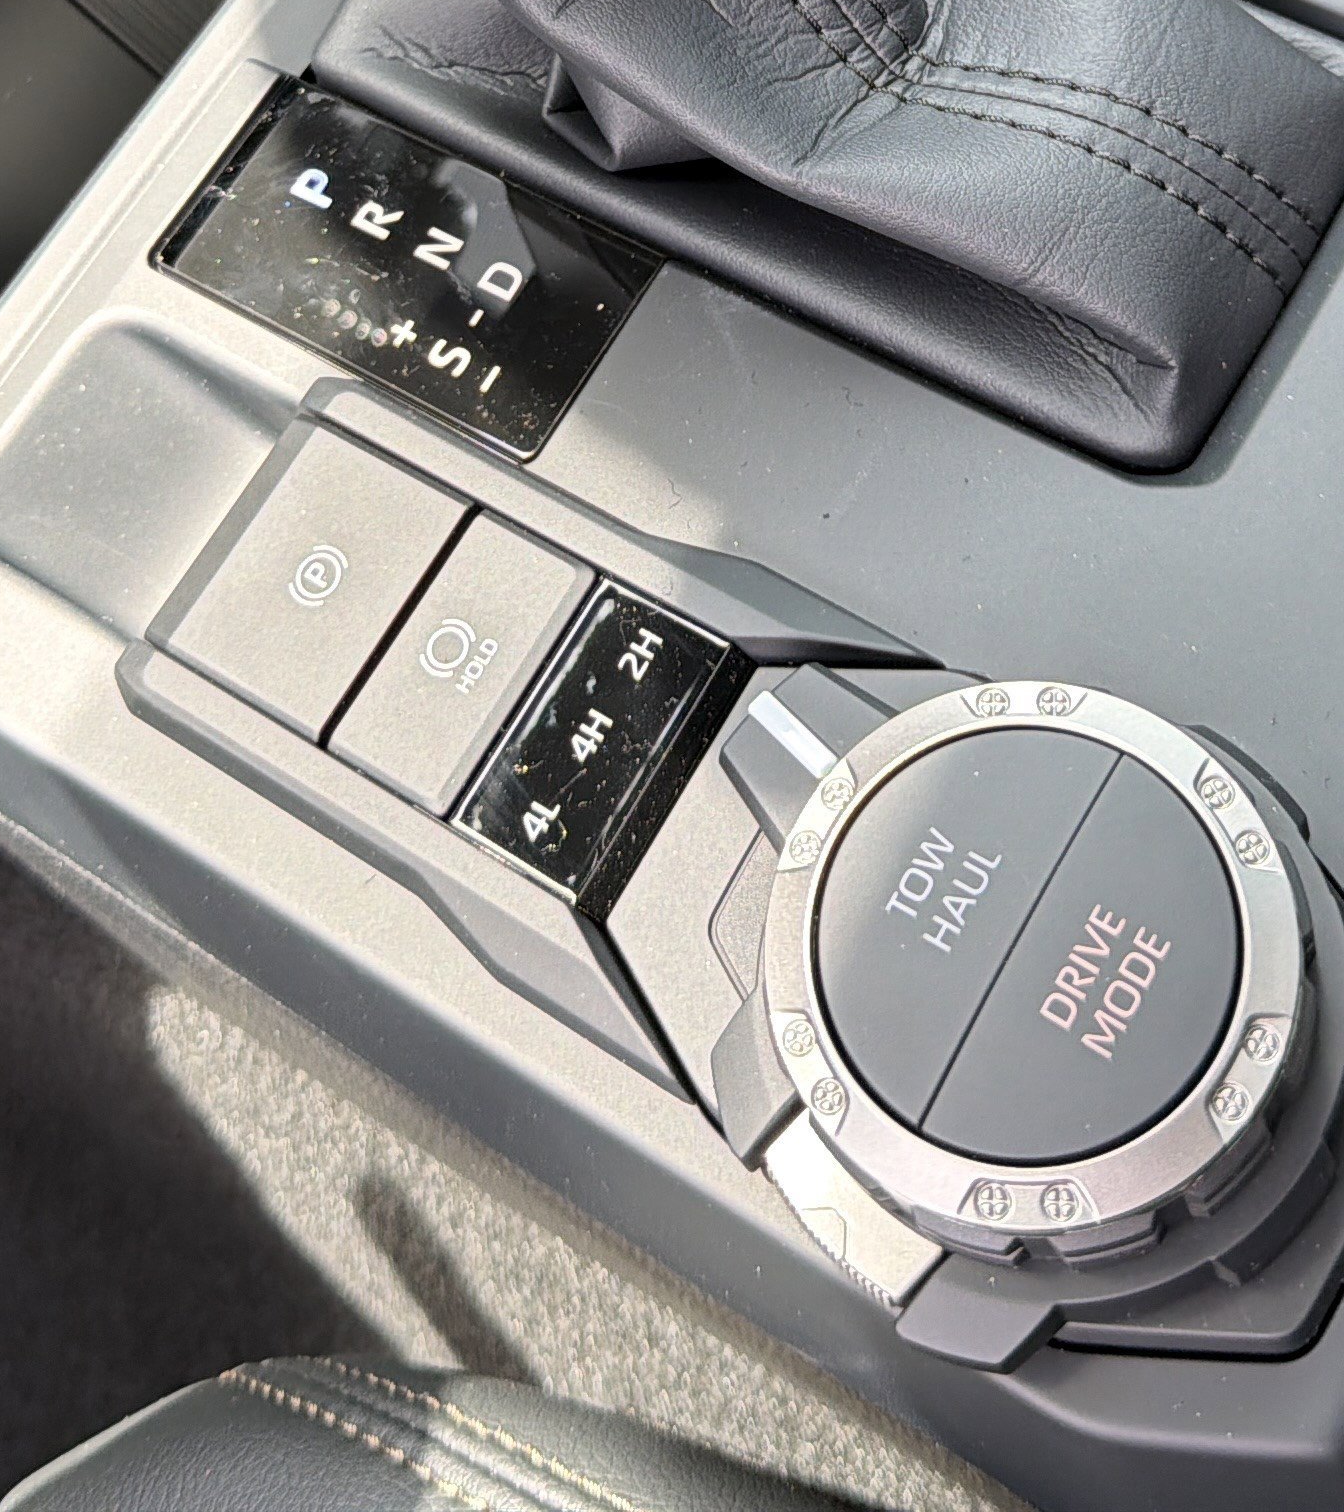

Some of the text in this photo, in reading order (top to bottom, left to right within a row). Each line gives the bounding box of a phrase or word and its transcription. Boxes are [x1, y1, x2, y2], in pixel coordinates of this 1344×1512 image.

[290, 168, 333, 209] P
[350, 200, 405, 241] R
[413, 226, 464, 270] N
[477, 261, 523, 303] D
[428, 338, 472, 378] S
[455, 637, 499, 694] HOLD
[617, 627, 664, 681] 2H
[571, 707, 614, 764] 4H
[523, 800, 561, 843] 4L
[885, 826, 955, 918] TOW
[922, 850, 1003, 953] HAUL
[1039, 903, 1127, 1031] DRIVE
[1080, 926, 1171, 1060] MODE
